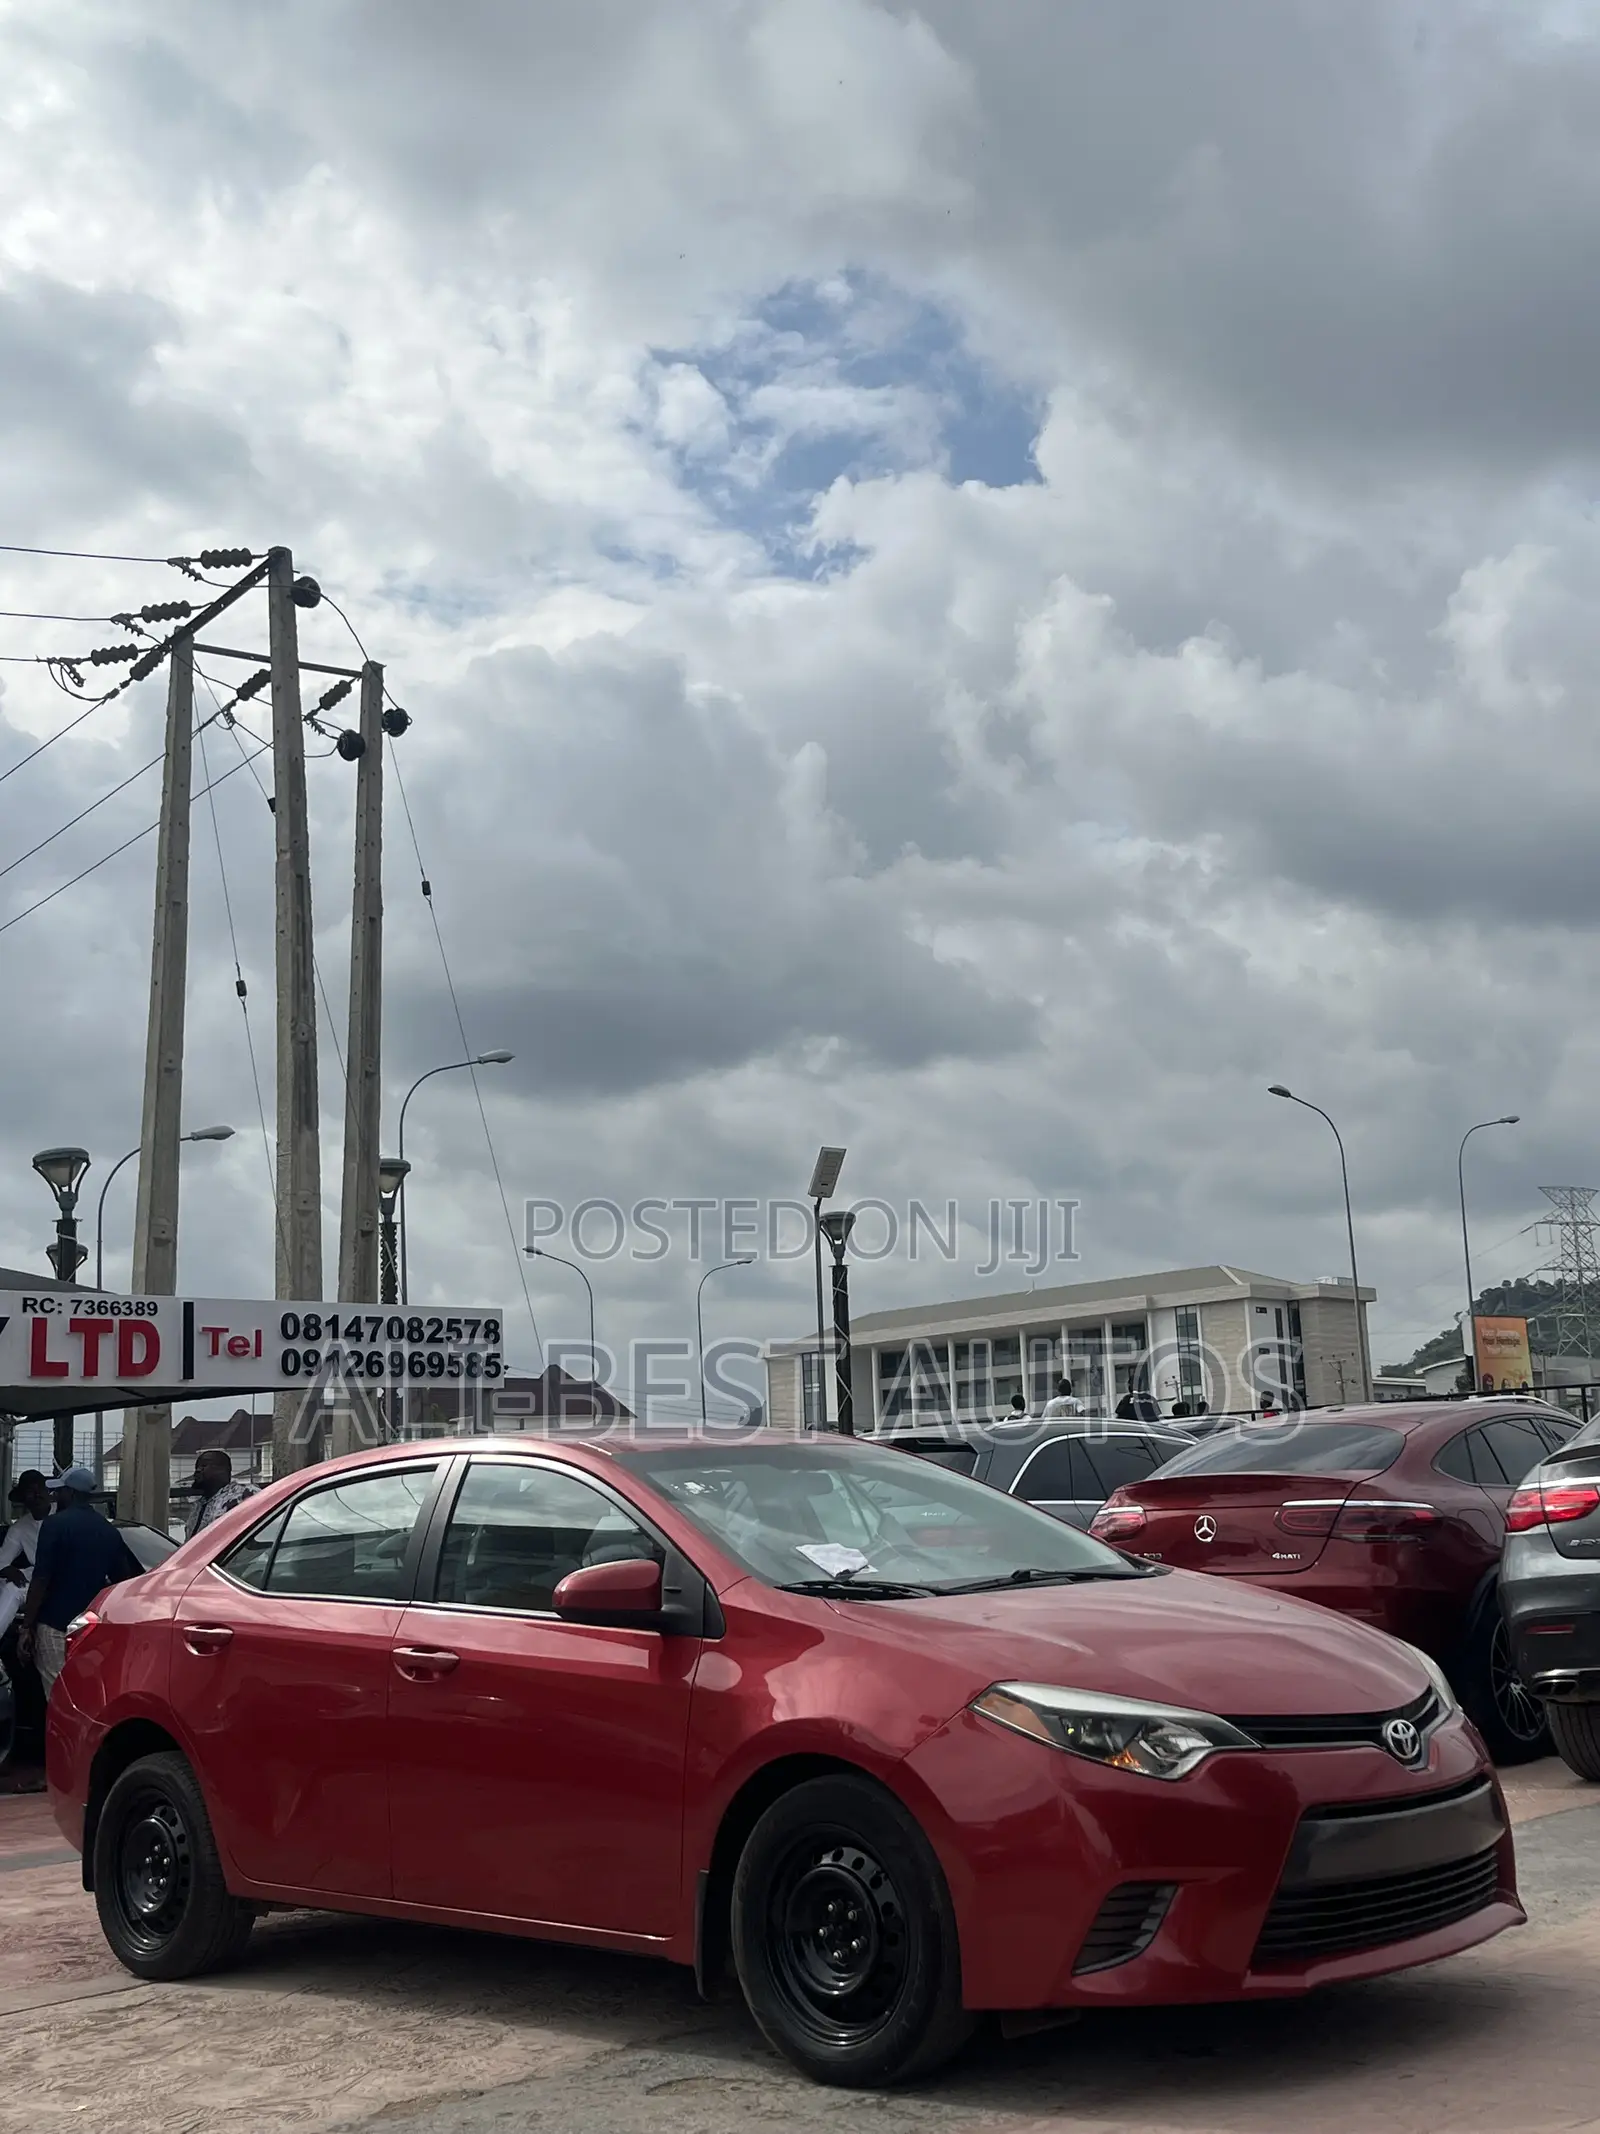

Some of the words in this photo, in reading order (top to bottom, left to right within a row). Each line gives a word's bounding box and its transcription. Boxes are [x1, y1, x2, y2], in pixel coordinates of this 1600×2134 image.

[22, 1297, 64, 1316] RC:
[70, 1299, 159, 1318] 7366389
[201, 1326, 263, 1358] Tel
[280, 1312, 501, 1344] 08147082578
[30, 1317, 161, 1378] LTD
[280, 1348, 501, 1379] 09126969585
